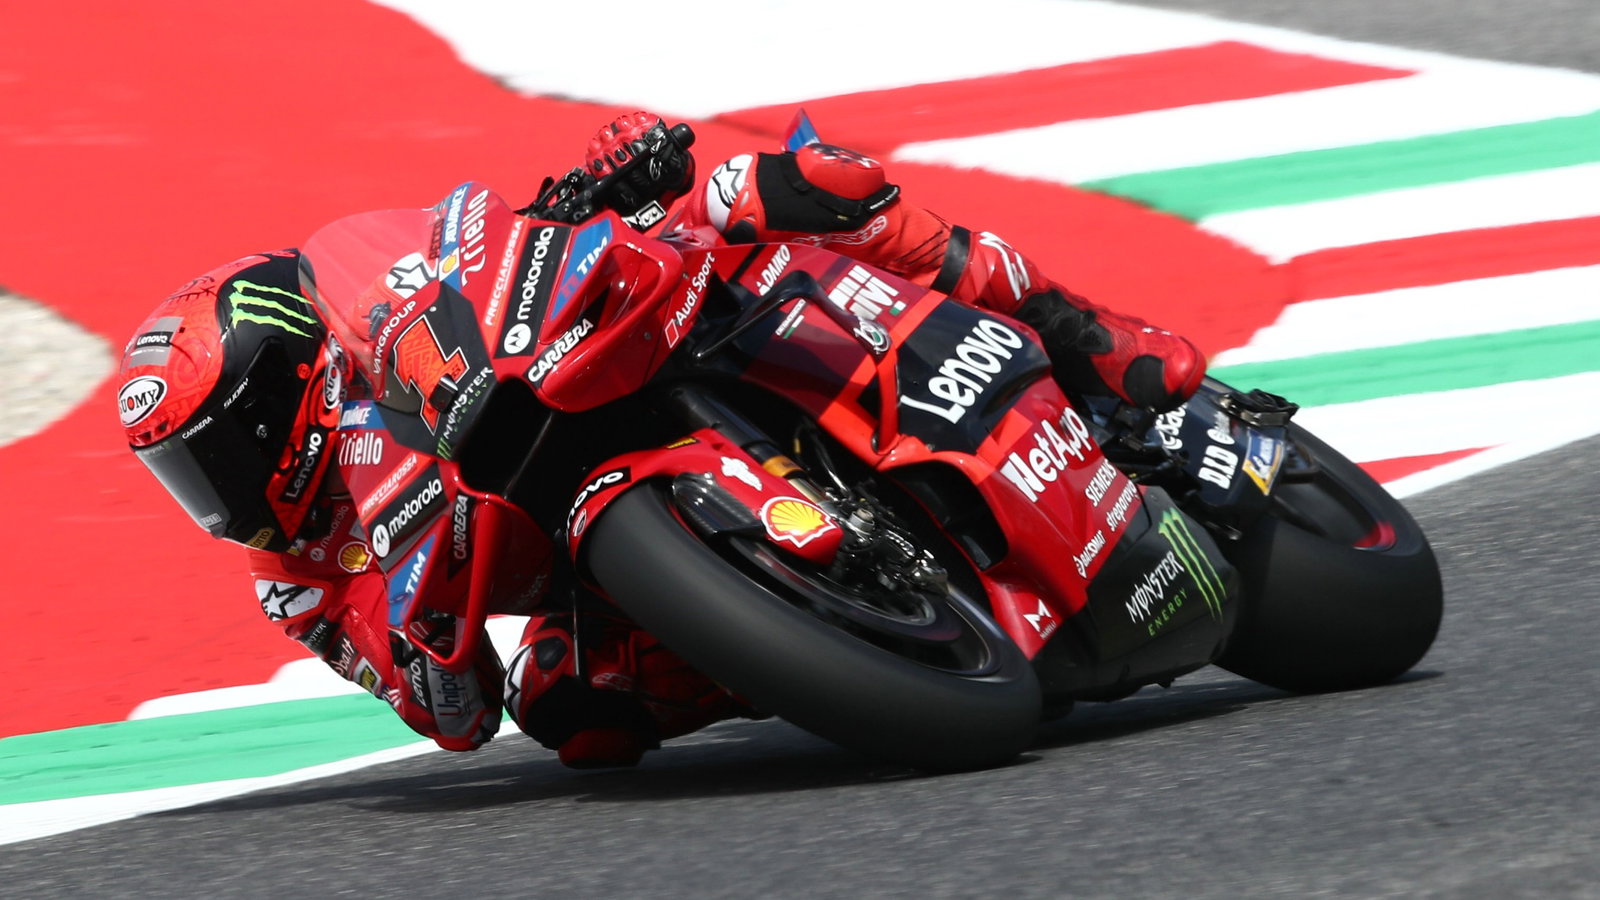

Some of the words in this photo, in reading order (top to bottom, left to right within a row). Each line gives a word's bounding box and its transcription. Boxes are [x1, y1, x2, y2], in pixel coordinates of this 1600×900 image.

[485, 220, 523, 326] FRECCIAROSSA
[517, 226, 555, 320] motorola
[576, 236, 608, 276] TIM
[761, 244, 791, 288] DAIKO
[675, 287, 698, 327] Audi
[692, 251, 716, 293] Sport
[136, 334, 169, 347] Lenovo
[528, 318, 594, 383] CARRERA
[223, 377, 249, 410] SUOMY
[900, 318, 1023, 425] Lenovo
[182, 415, 215, 440] CARRERA
[443, 366, 494, 440] MONSTER
[285, 432, 322, 498] Lenovo
[361, 453, 418, 515] FRECCIAROSSA
[1085, 458, 1117, 508] SIEMENS
[320, 505, 349, 549] motorola
[388, 478, 443, 538] motorola
[454, 494, 468, 560] CARRERA
[405, 550, 427, 596] TIM
[1125, 550, 1185, 624] MONSTER
[1147, 587, 1187, 637] ENERGY
